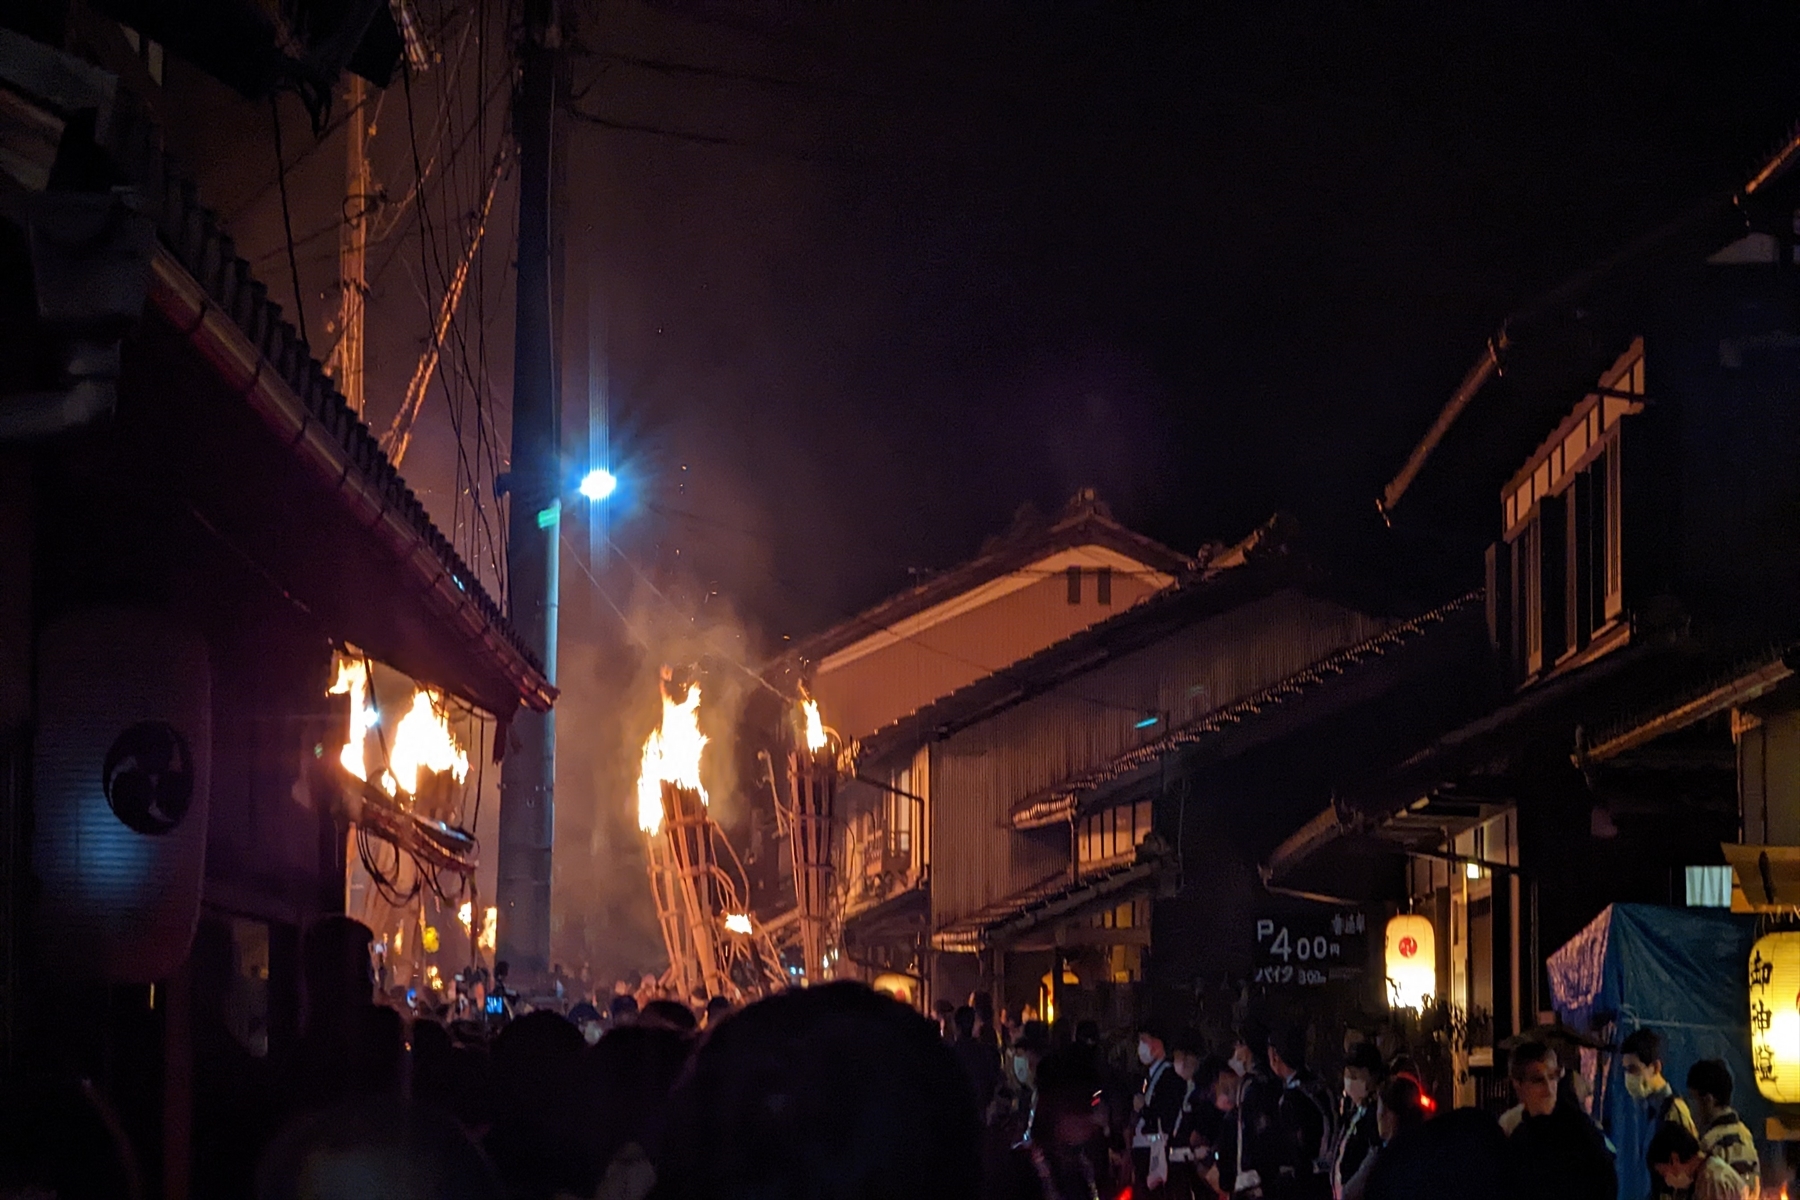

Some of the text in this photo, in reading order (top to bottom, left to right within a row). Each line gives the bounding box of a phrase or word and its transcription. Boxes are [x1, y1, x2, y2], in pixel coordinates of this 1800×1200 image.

[1256, 918, 1275, 943] P
[1254, 964, 1294, 984] バイク
